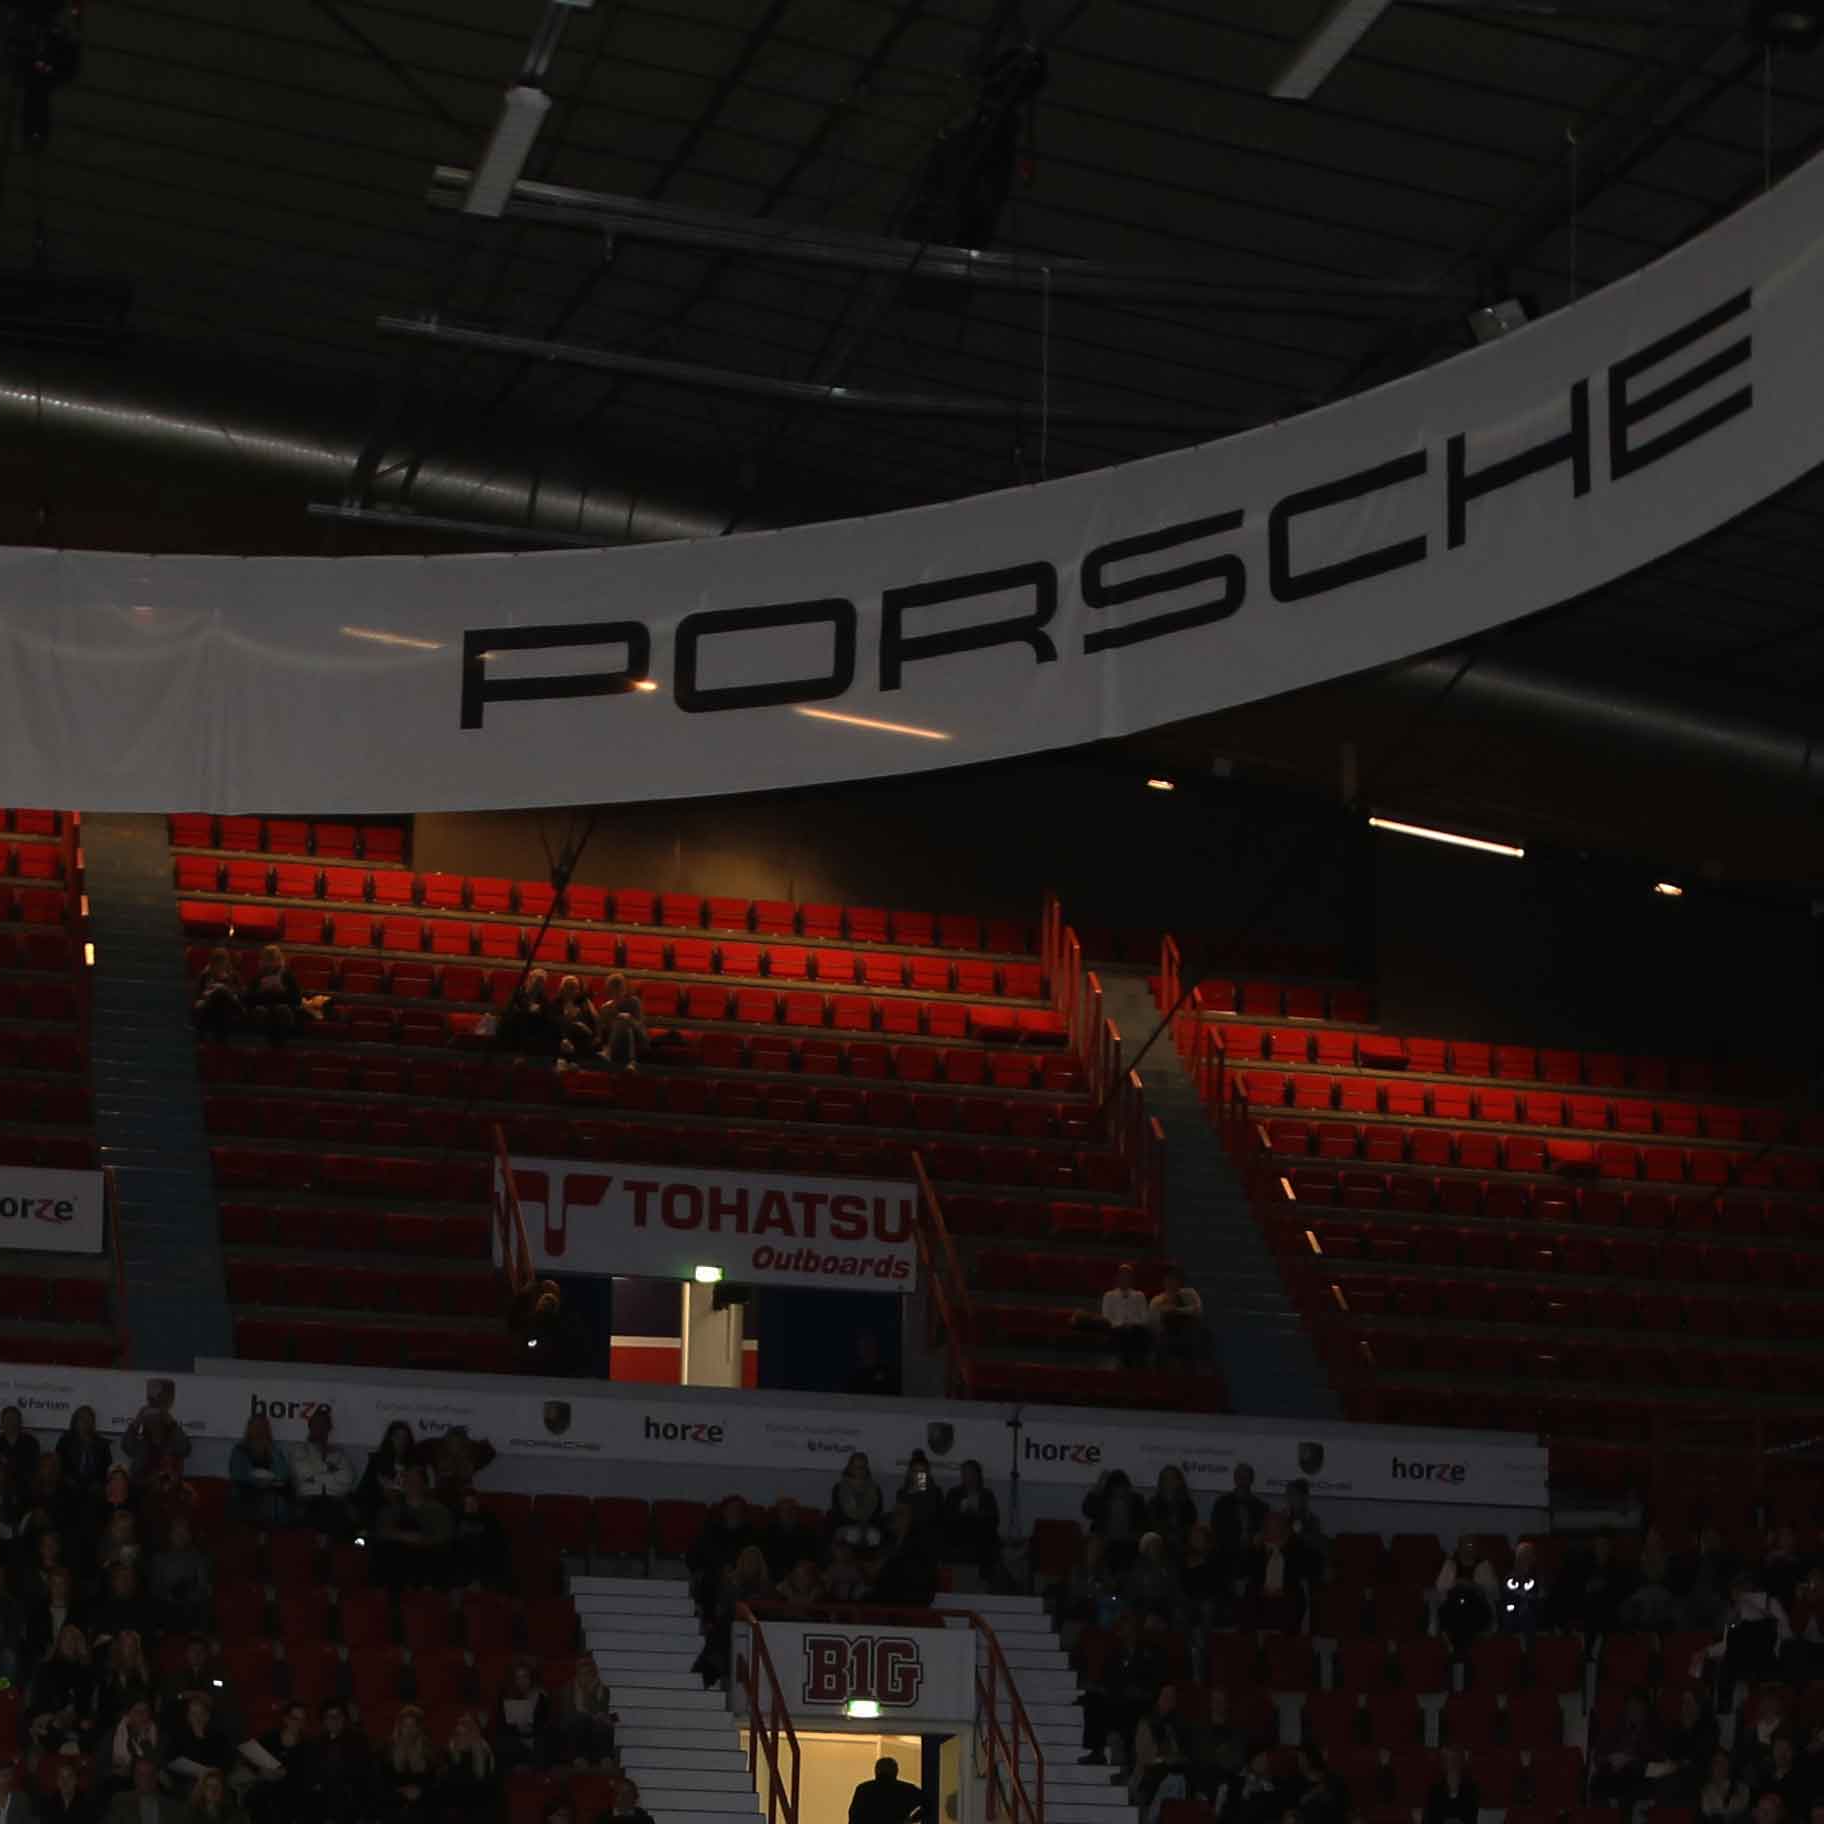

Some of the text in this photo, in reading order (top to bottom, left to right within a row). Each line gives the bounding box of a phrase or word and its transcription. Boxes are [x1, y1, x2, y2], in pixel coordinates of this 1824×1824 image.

[459, 288, 1753, 729] PORSCHE
[623, 1180, 917, 1243] TOHATSU
[752, 1245, 910, 1281] Outboards
[644, 1416, 724, 1444] horze
[1026, 1436, 1102, 1463] horze
[1392, 1456, 1466, 1485] horze
